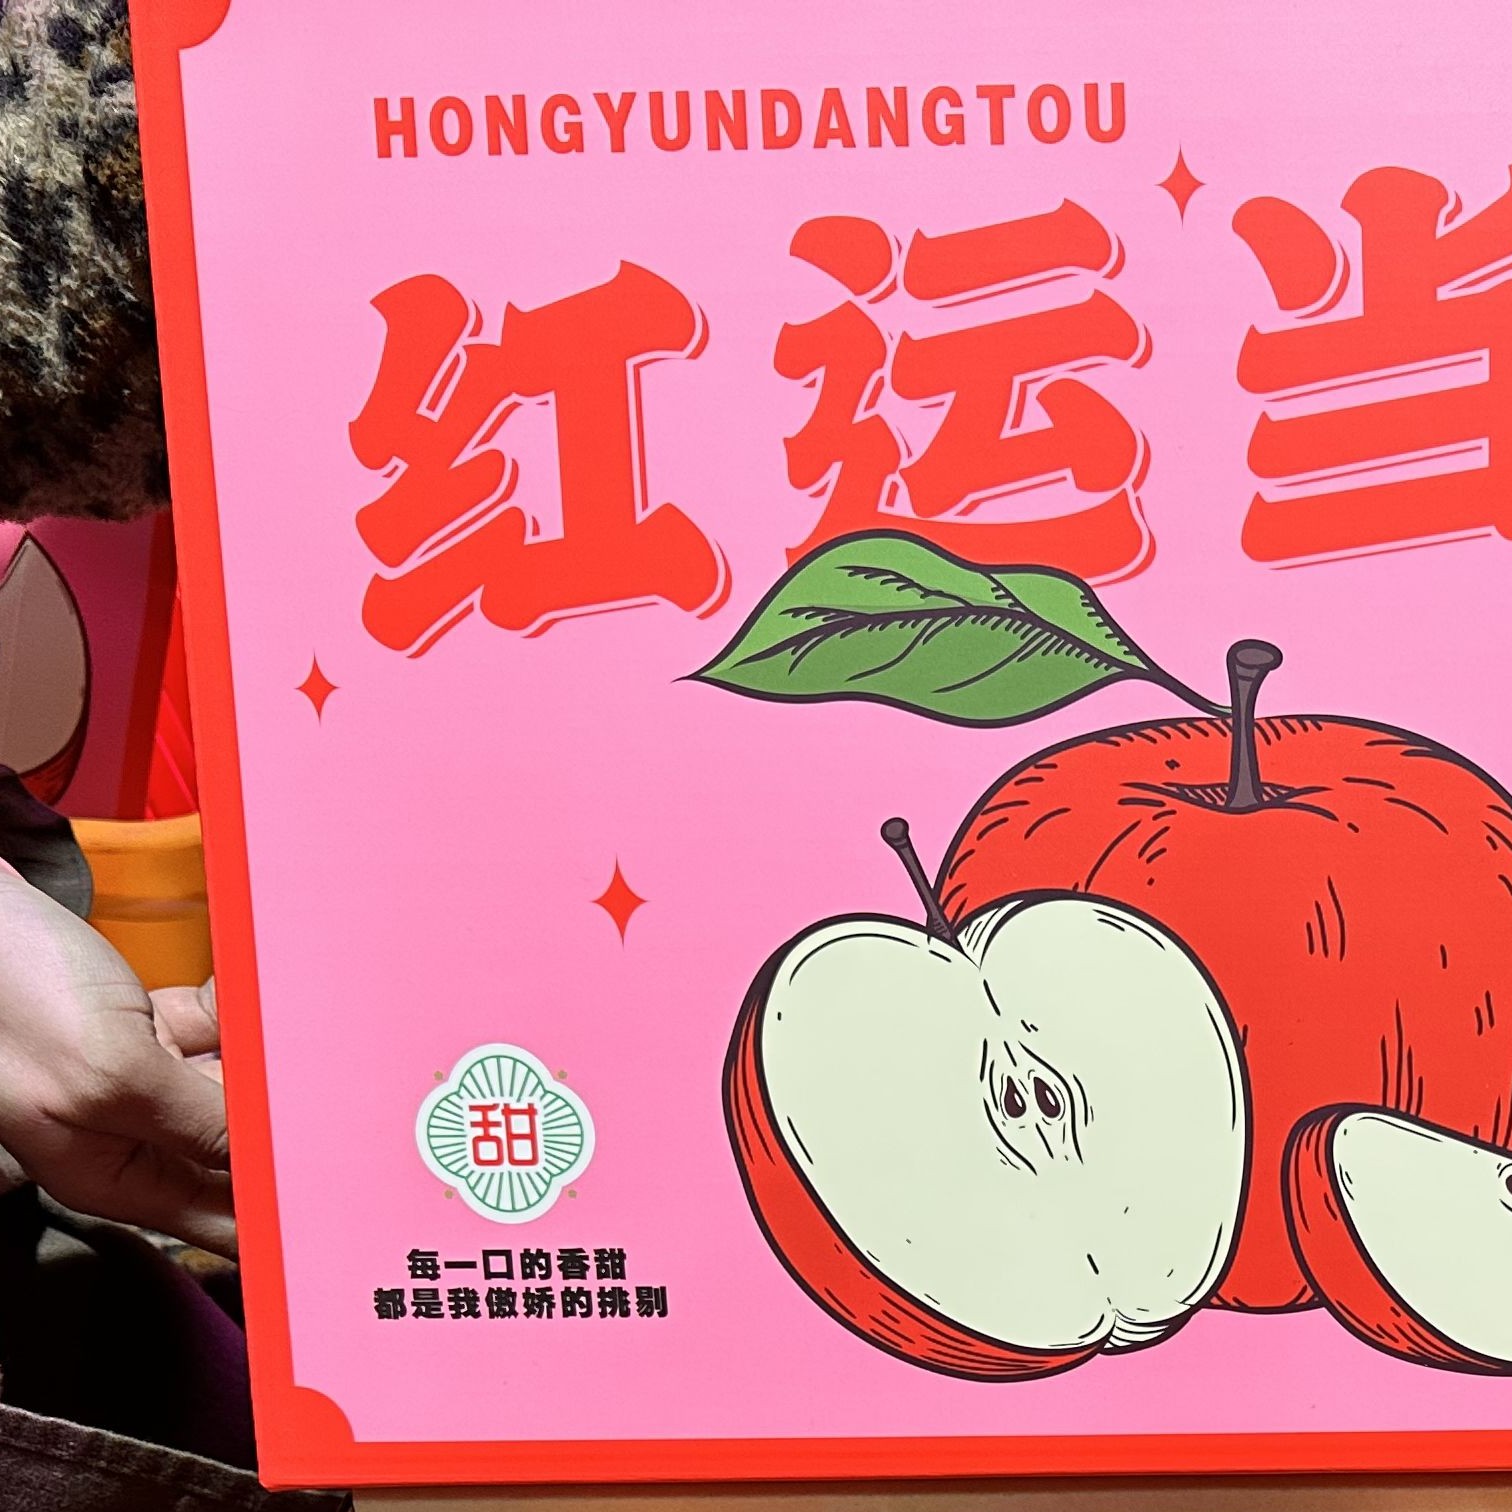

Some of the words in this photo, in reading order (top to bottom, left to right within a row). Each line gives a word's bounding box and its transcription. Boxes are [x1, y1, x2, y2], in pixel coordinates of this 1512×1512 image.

[372, 80, 1128, 160] HONGYUNDANGTOU
[468, 1102, 540, 1167] 甜
[405, 1247, 628, 1281] 每一口的香甜
[372, 1284, 669, 1321] 都是我傲娇的挑剔
